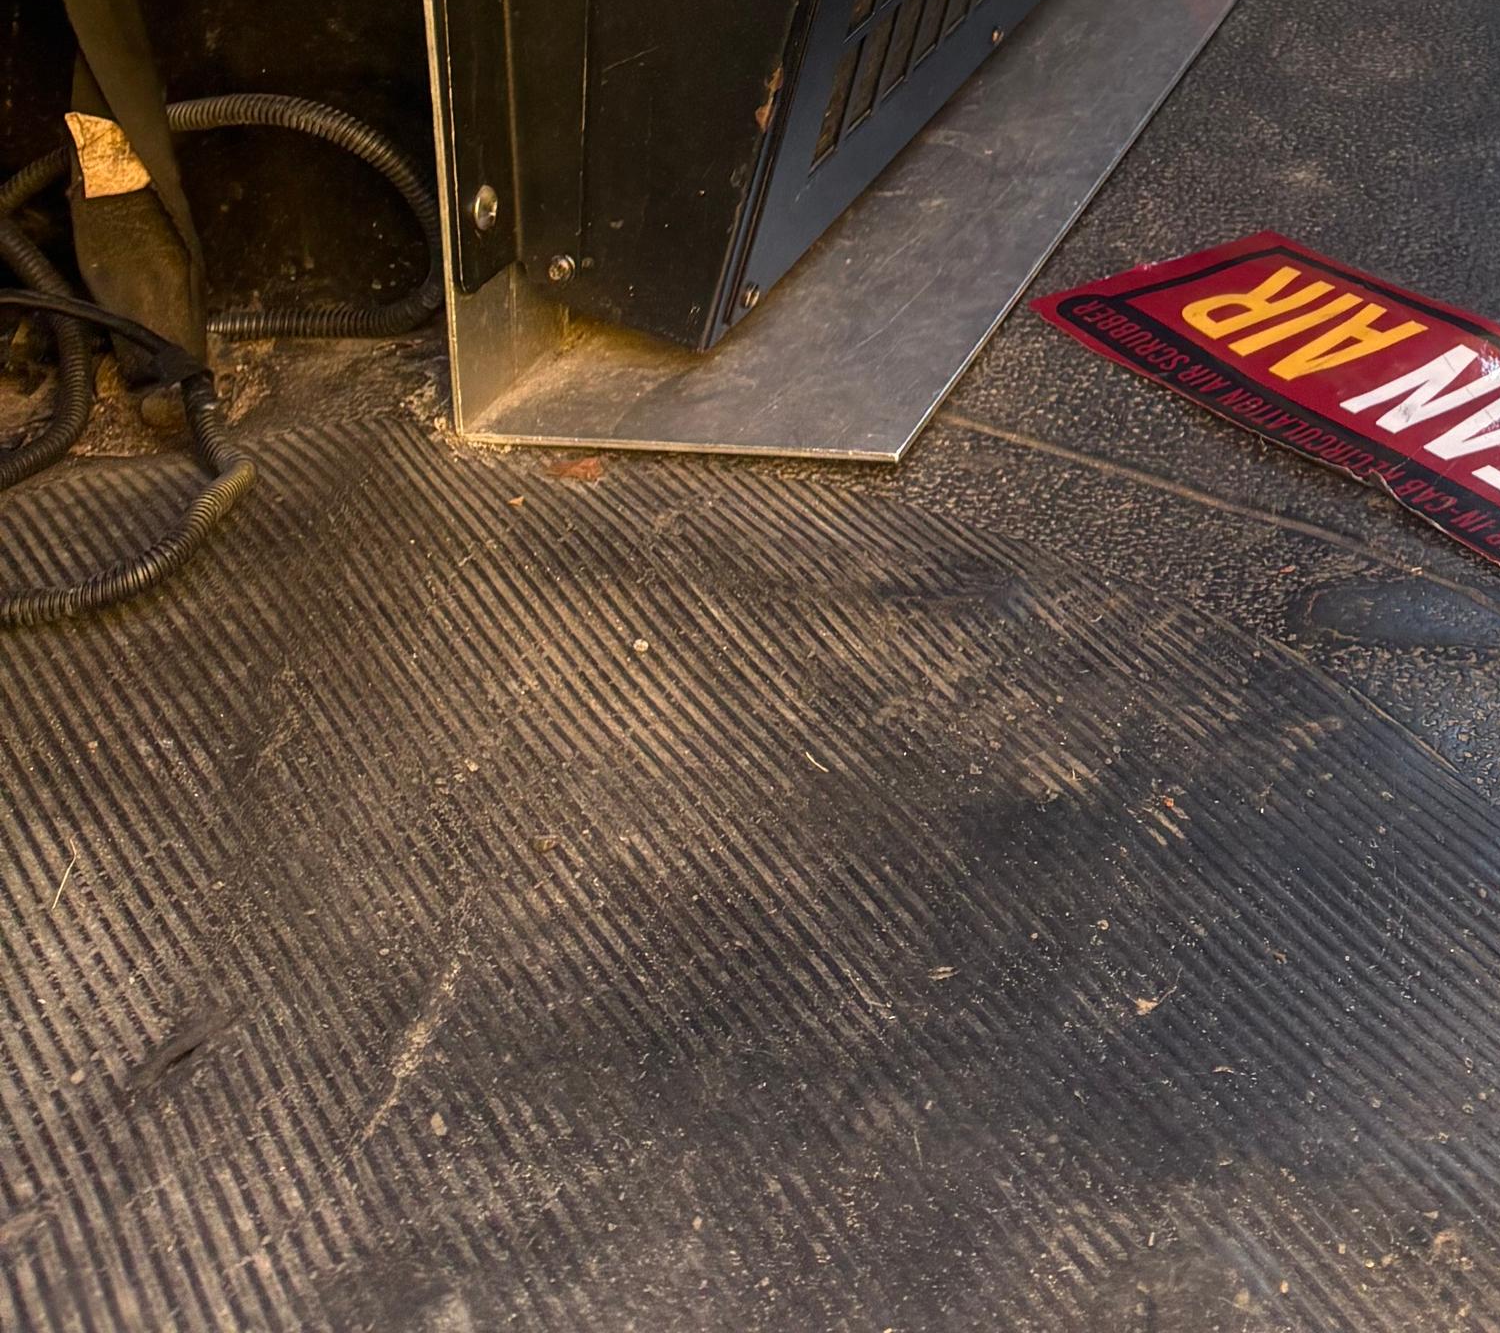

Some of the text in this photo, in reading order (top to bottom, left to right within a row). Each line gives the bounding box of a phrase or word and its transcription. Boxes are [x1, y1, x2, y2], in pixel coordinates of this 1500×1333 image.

[1072, 299, 1190, 372] SCRUBBER
[1182, 265, 1430, 381] AIR
[1177, 364, 1232, 393] AIR
[1395, 478, 1497, 532] IN-CAB
